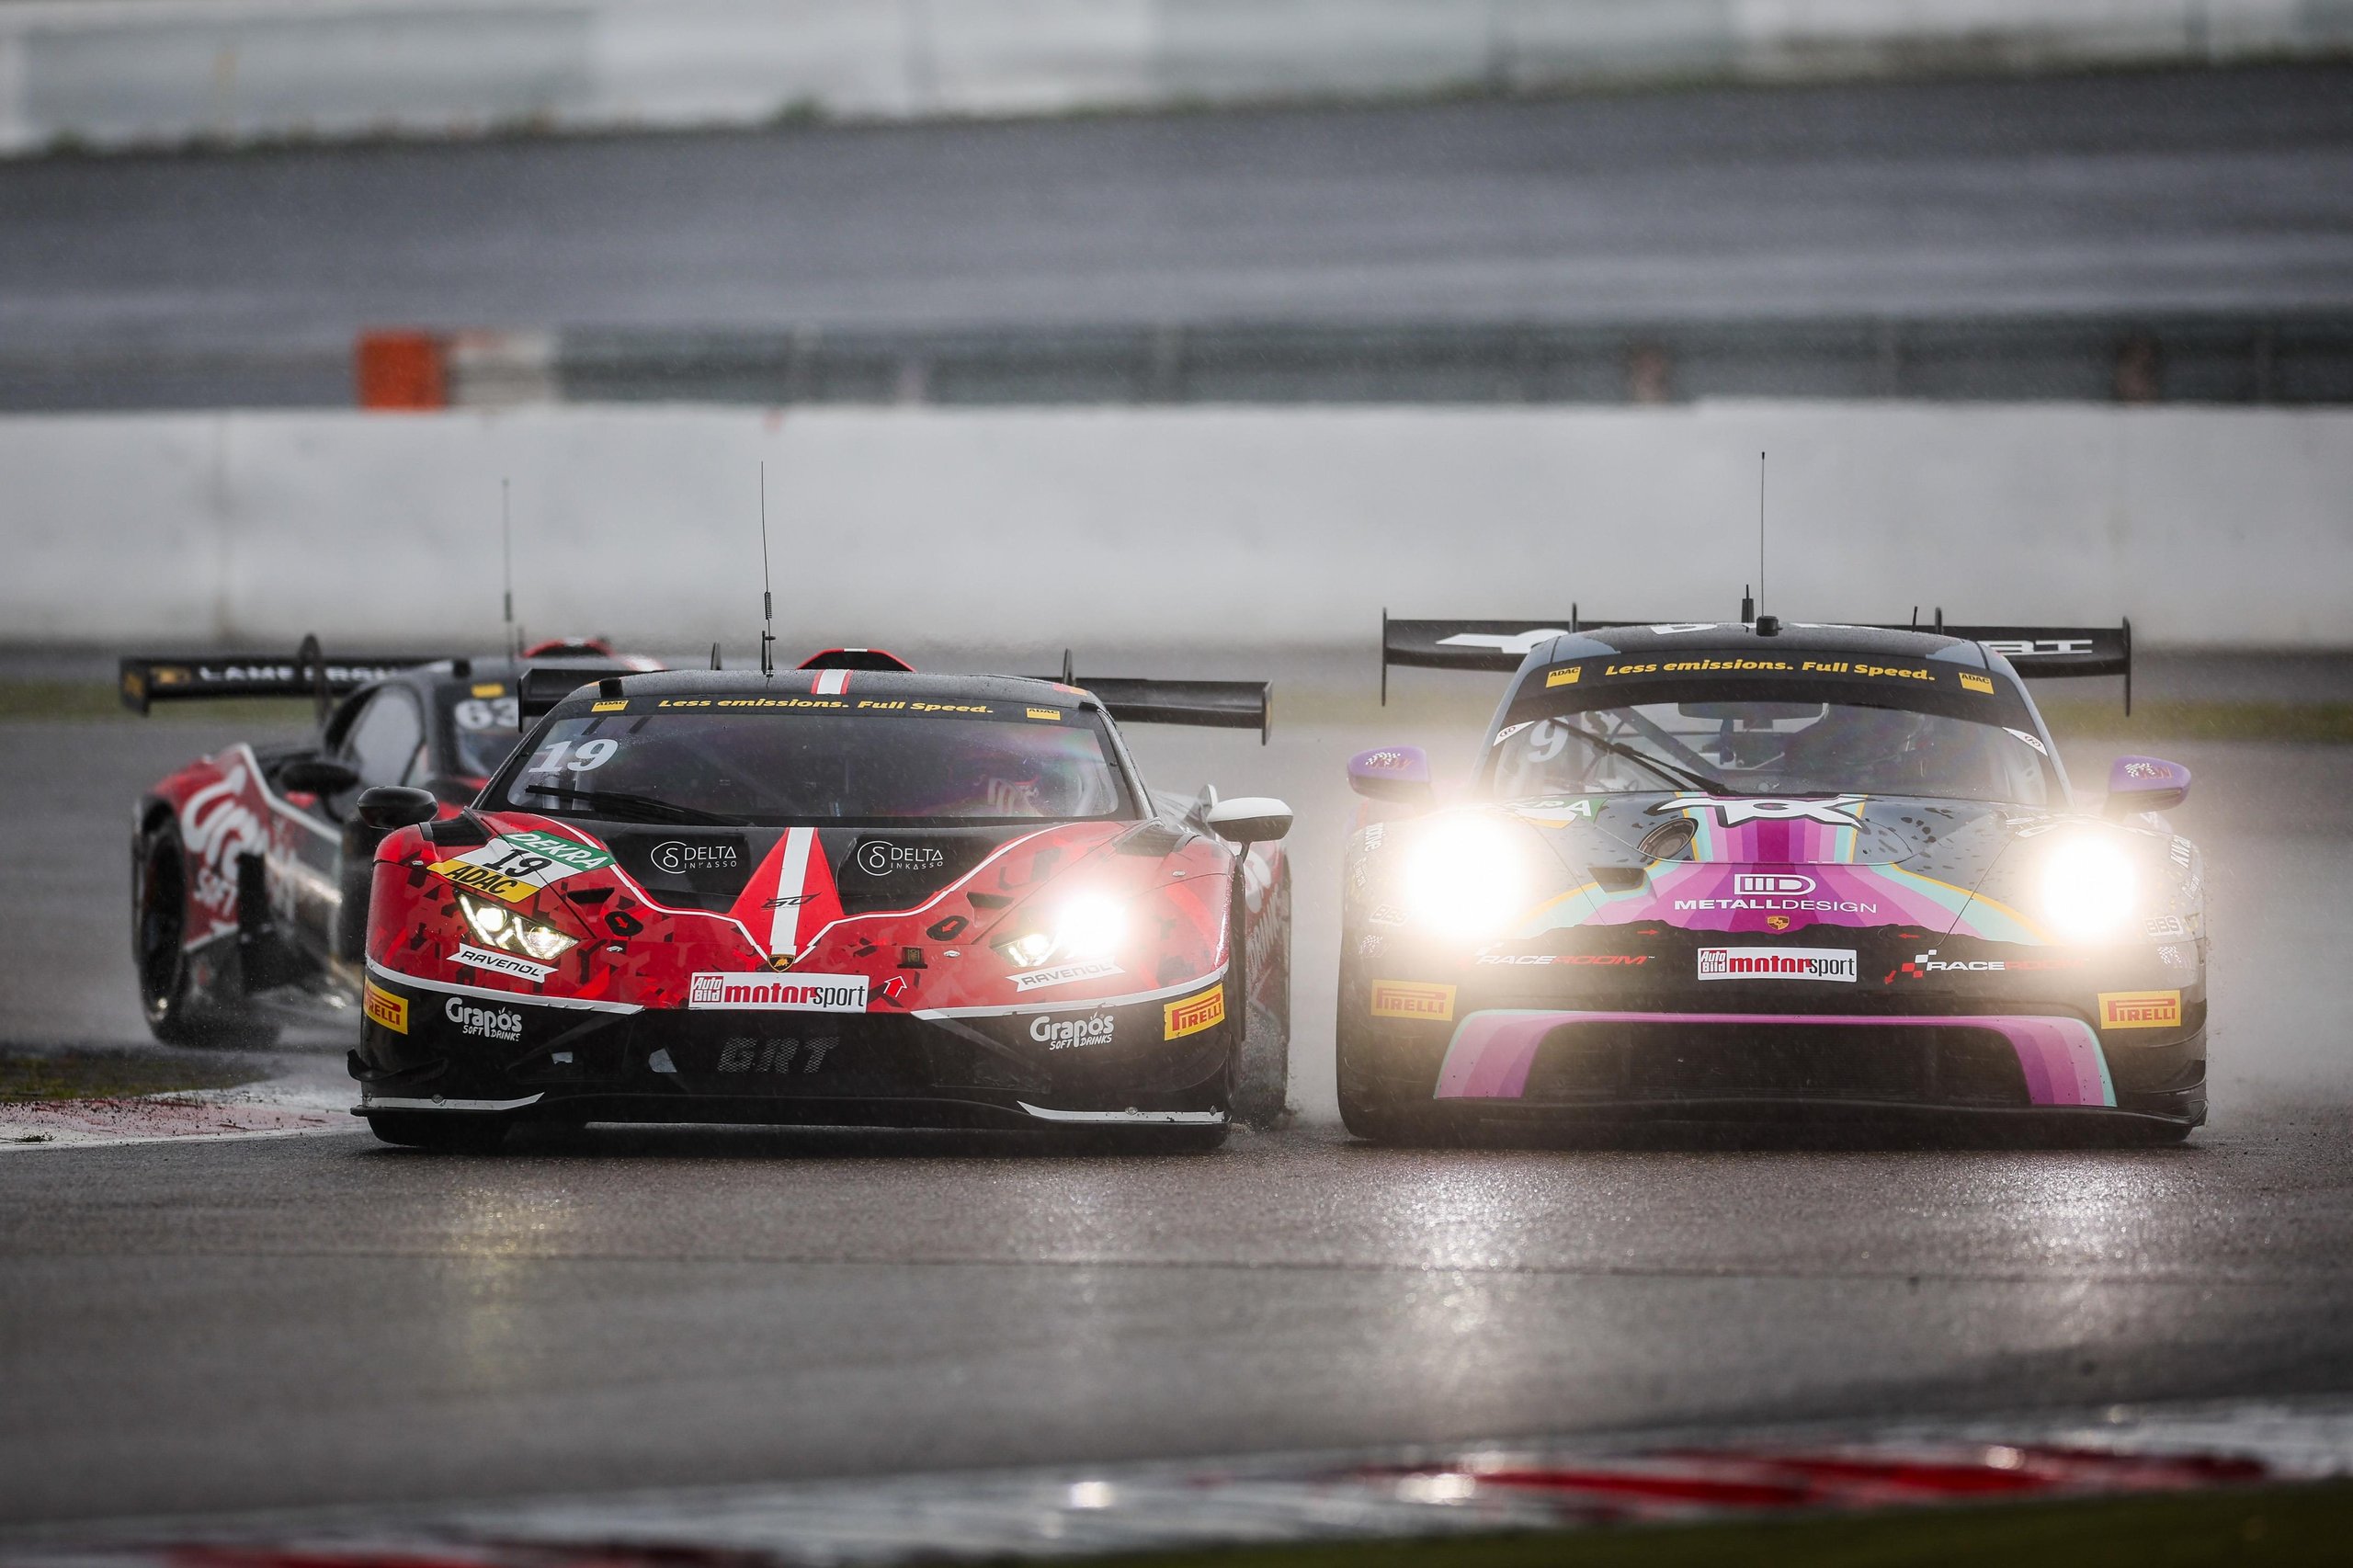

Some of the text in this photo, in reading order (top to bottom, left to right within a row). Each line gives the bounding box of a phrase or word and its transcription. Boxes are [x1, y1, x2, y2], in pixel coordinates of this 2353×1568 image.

[1549, 666, 1580, 678] ADAC
[1605, 658, 1937, 681] Less emissions. Full Speed.
[1961, 673, 1992, 685] ADAC
[658, 698, 995, 714] Less emissions. Full Speed.
[529, 738, 620, 773] 19
[506, 833, 611, 869] DEKRA
[685, 846, 736, 861] DELTA
[891, 846, 944, 862] DELTA
[482, 848, 553, 878] 19
[891, 860, 944, 871] INKASSO
[444, 865, 518, 895] ADAC
[1674, 899, 1877, 914] METALLDESIGN
[460, 949, 540, 977] RAVENOL
[1700, 950, 1726, 963] Auto
[1729, 954, 1856, 977] motorsport
[1020, 962, 1112, 986] RAVENOL
[1701, 961, 1726, 973] Bild
[694, 976, 723, 990] Auto
[693, 989, 721, 1002] Bild
[724, 983, 866, 1008] motorsport
[1377, 986, 1446, 1014] PIRELLI
[1171, 992, 1222, 1032] PIRELLI
[2108, 998, 2176, 1022] PIRELLI
[462, 1025, 483, 1037] SOFT
[1049, 1034, 1112, 1051] SOFT DRINKS
[716, 1035, 841, 1074] GRT
